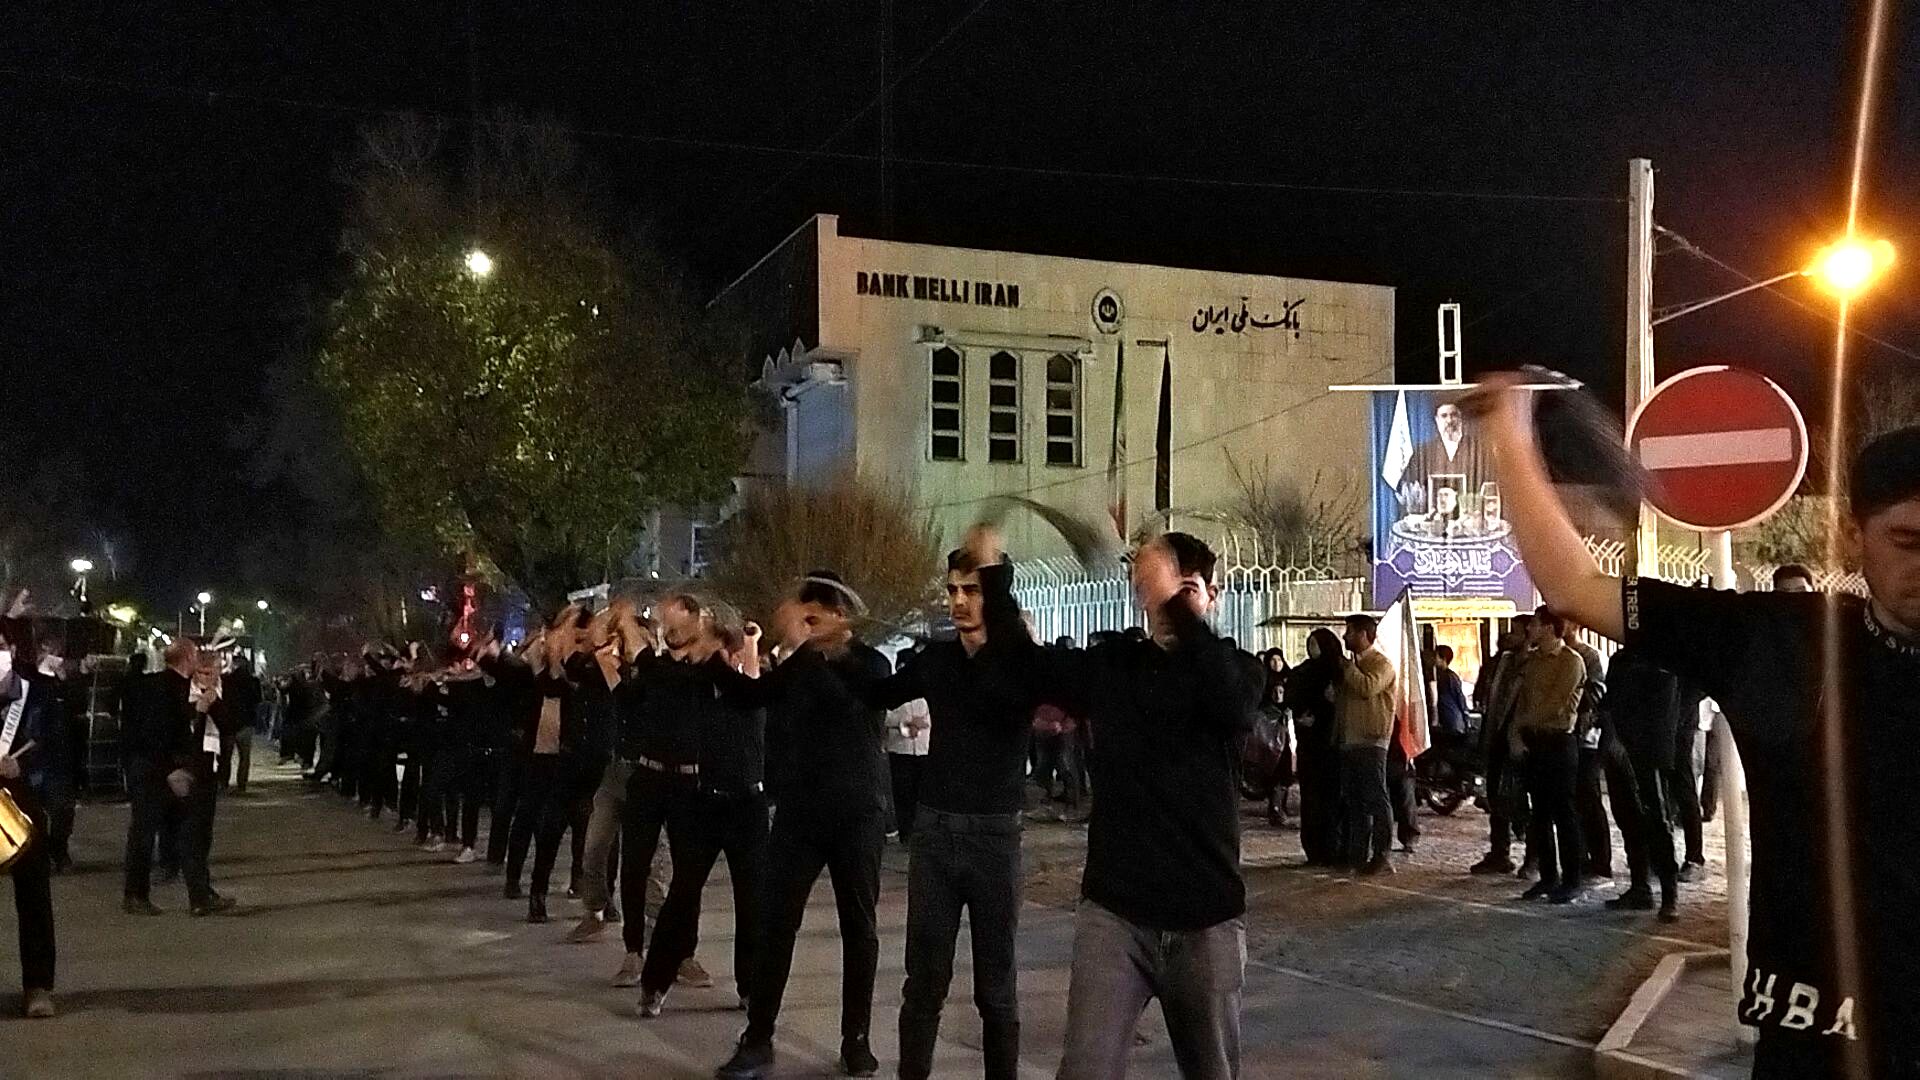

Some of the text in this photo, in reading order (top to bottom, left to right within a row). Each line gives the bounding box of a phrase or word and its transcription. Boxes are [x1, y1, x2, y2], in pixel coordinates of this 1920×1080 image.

[857, 272, 1020, 309] BANK MELLI IRAN
[1192, 305, 1229, 335] ایران
[1250, 298, 1306, 339] بانک
[1625, 589, 1640, 630] TREND
